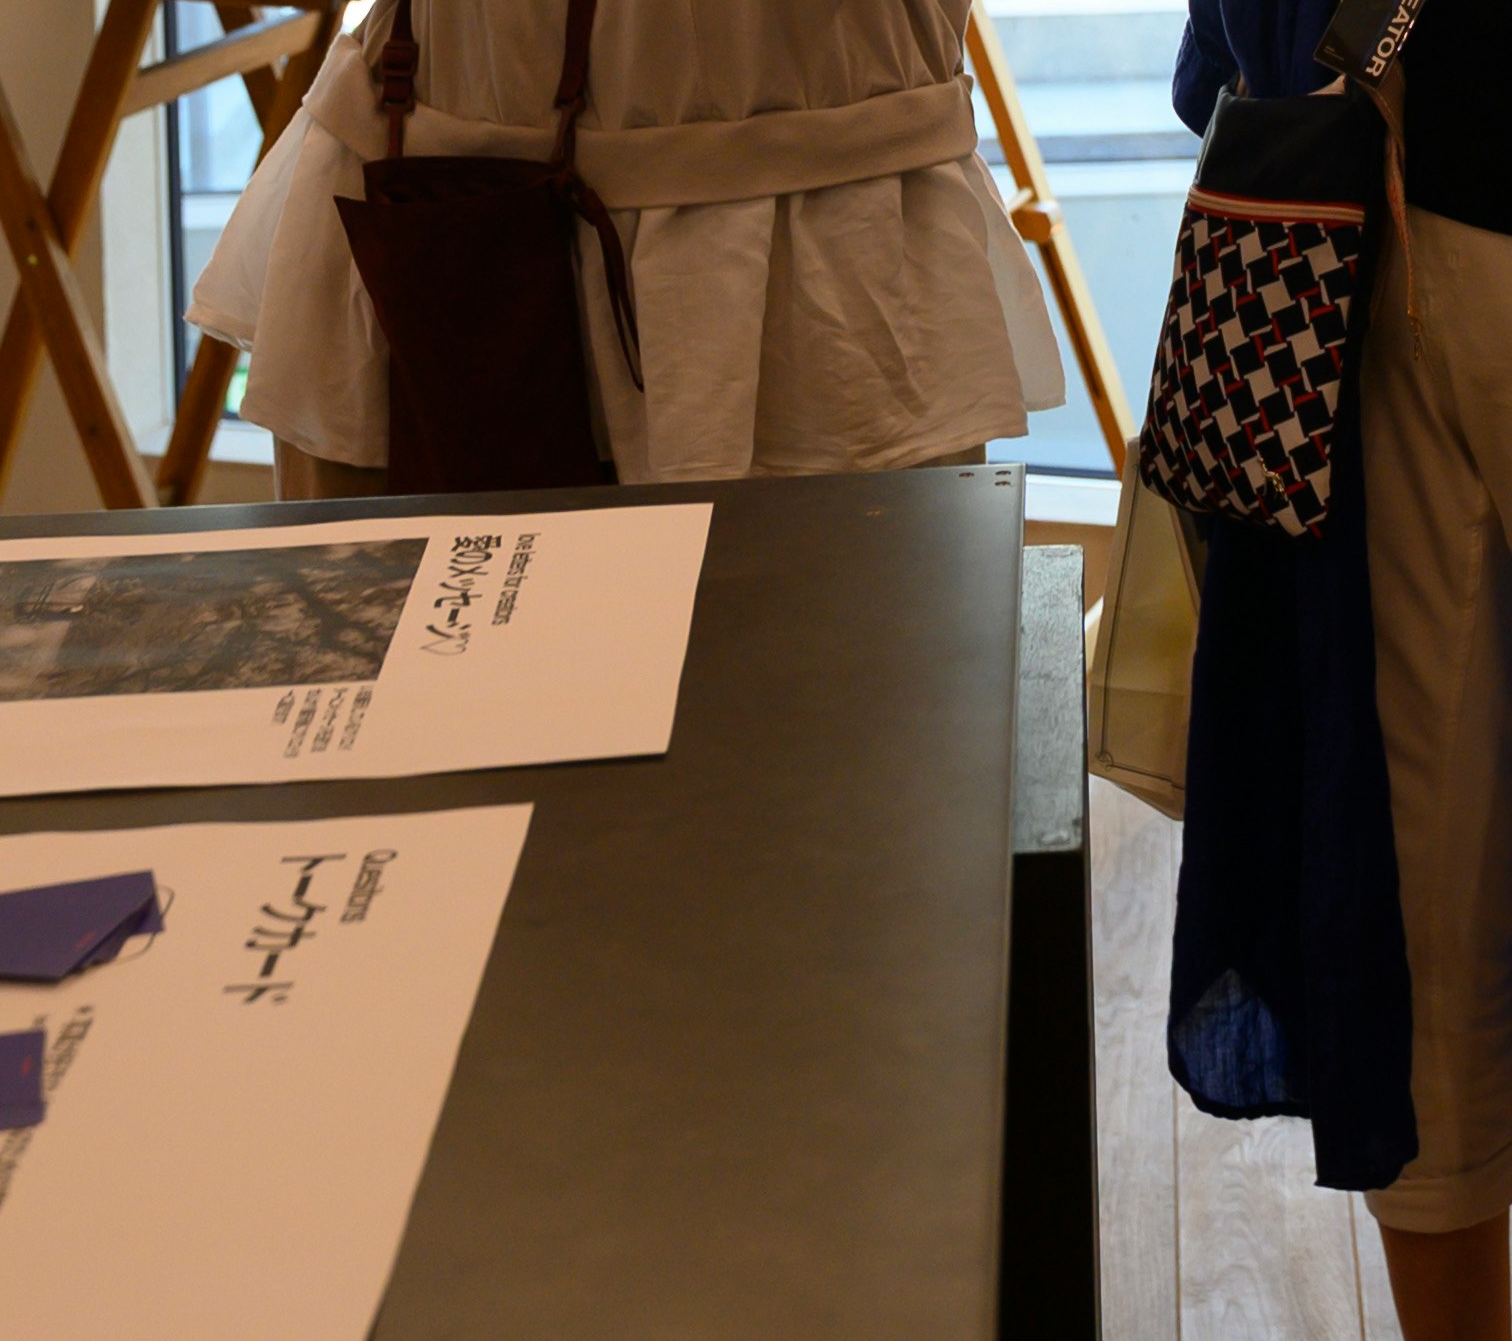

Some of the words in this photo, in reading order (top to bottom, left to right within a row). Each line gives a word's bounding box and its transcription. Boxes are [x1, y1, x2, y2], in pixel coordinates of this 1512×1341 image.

[222, 852, 348, 1005] トークカード
